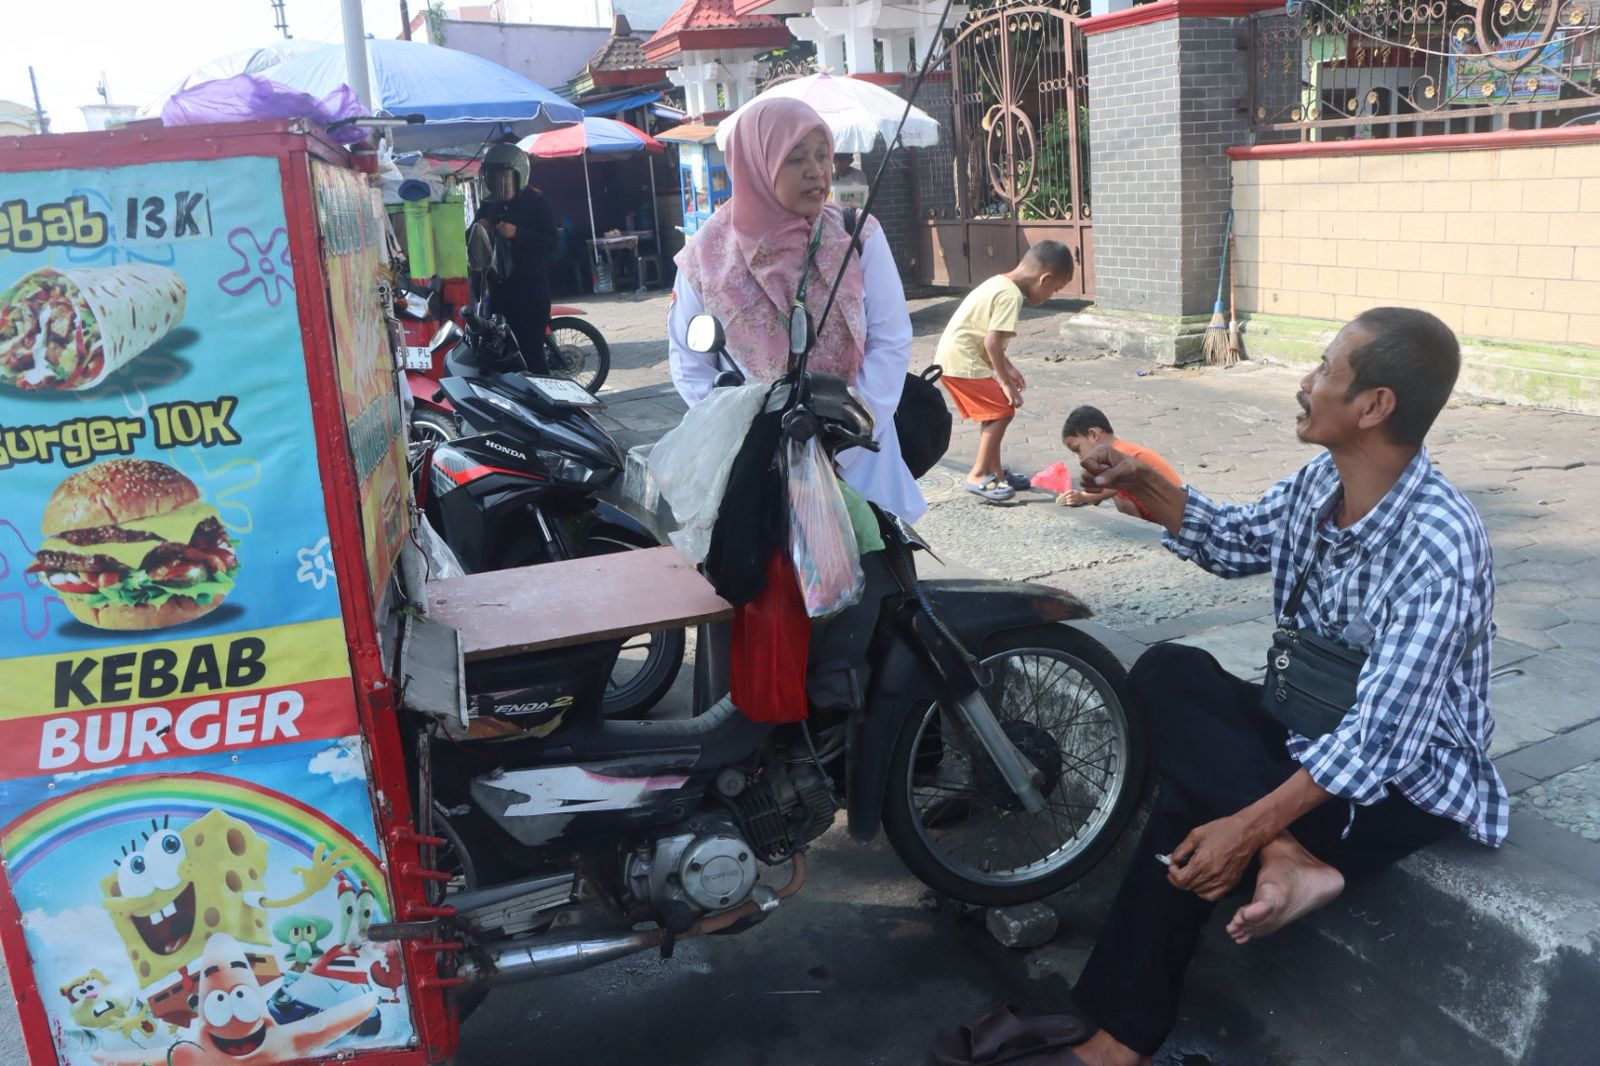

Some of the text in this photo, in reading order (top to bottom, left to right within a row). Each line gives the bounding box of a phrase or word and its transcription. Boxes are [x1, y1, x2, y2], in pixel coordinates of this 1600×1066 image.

[126, 189, 203, 239] 13K
[148, 396, 242, 449] 10K
[485, 439, 527, 460] HONDA
[54, 637, 266, 708] KEBAB
[38, 690, 304, 770] BURGER
